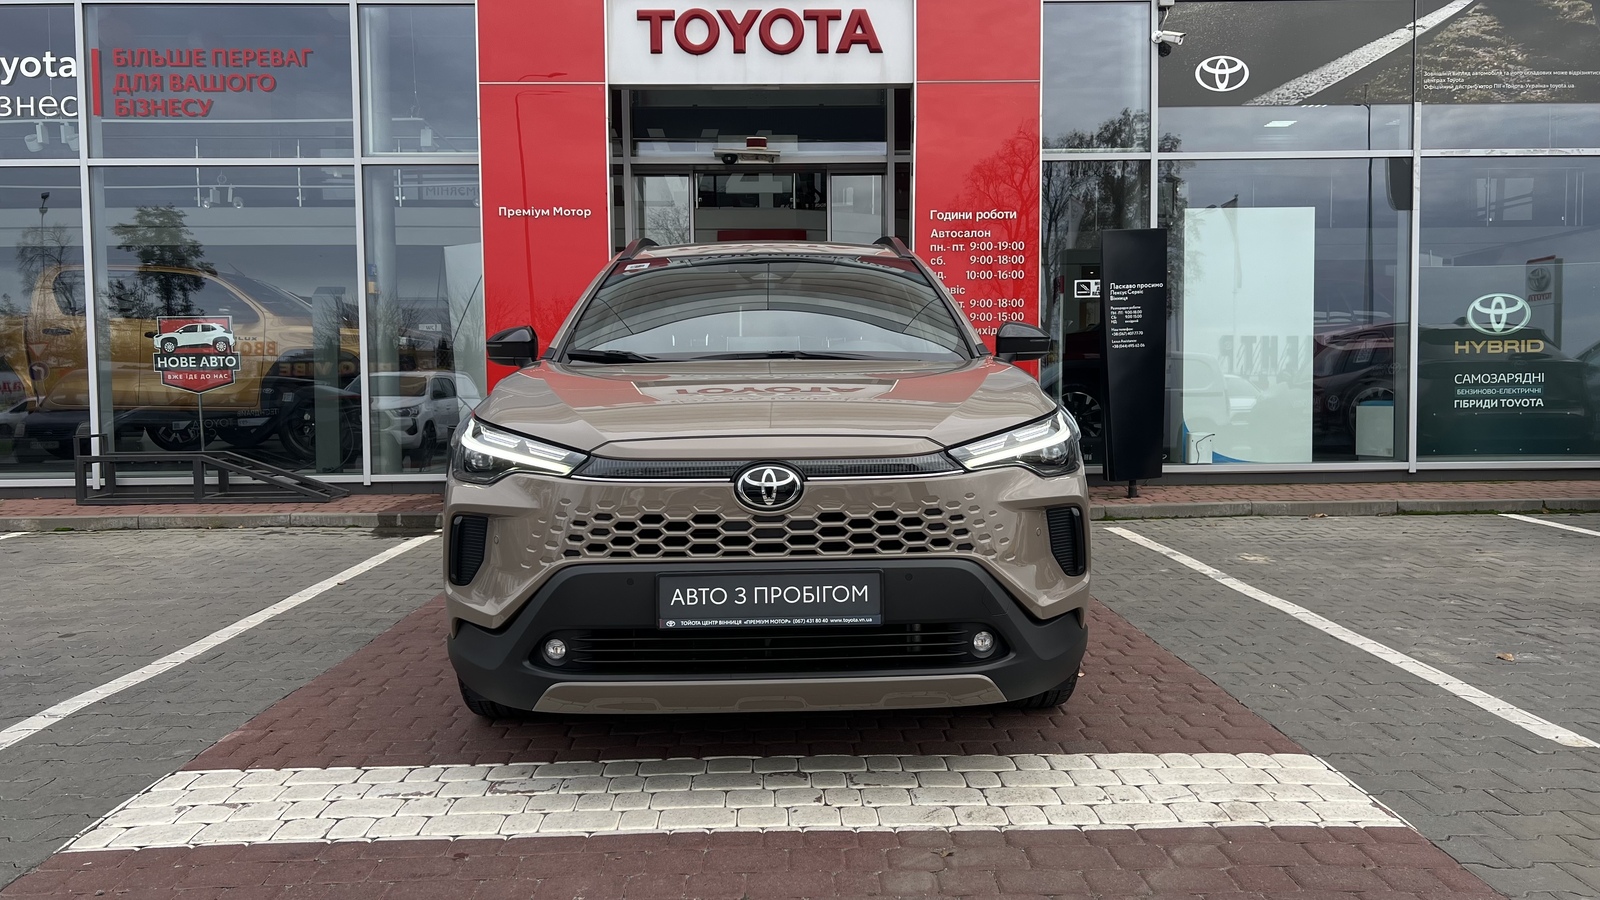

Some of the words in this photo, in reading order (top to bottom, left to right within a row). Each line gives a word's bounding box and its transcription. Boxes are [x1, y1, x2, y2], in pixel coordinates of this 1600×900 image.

[637, 8, 883, 55] TOYOTA
[113, 48, 206, 67] БІЛЬШЕ
[211, 48, 313, 67] ПЕРЕВАГ
[113, 73, 163, 95] ДЛЯ
[169, 73, 276, 92] ВАШОГО
[114, 98, 213, 117] БІЗНЕСУ
[498, 206, 550, 218] Преміум
[553, 206, 592, 218] Мотор
[930, 210, 973, 221] Години
[976, 209, 1017, 222] роботи
[930, 228, 991, 238] Автосалон
[930, 256, 946, 266] сб.
[1137, 282, 1164, 290] просимо
[1454, 339, 1545, 354] HYBRID
[157, 356, 197, 368] НОВЕ
[199, 355, 237, 368] АВТО
[1454, 372, 1545, 384] САМОЗАРЯДНІ
[1456, 387, 1542, 395] БЕНЗИНОВО-ЕЛЕКТРИЧНІ
[1454, 399, 1498, 409] ГІБРИДИ
[1500, 398, 1544, 408] TOYOTA
[670, 587, 728, 606] АВТО
[734, 586, 747, 605] З
[754, 584, 868, 604] ПРОБІГОМ
[792, 617, 806, 625] (067)
